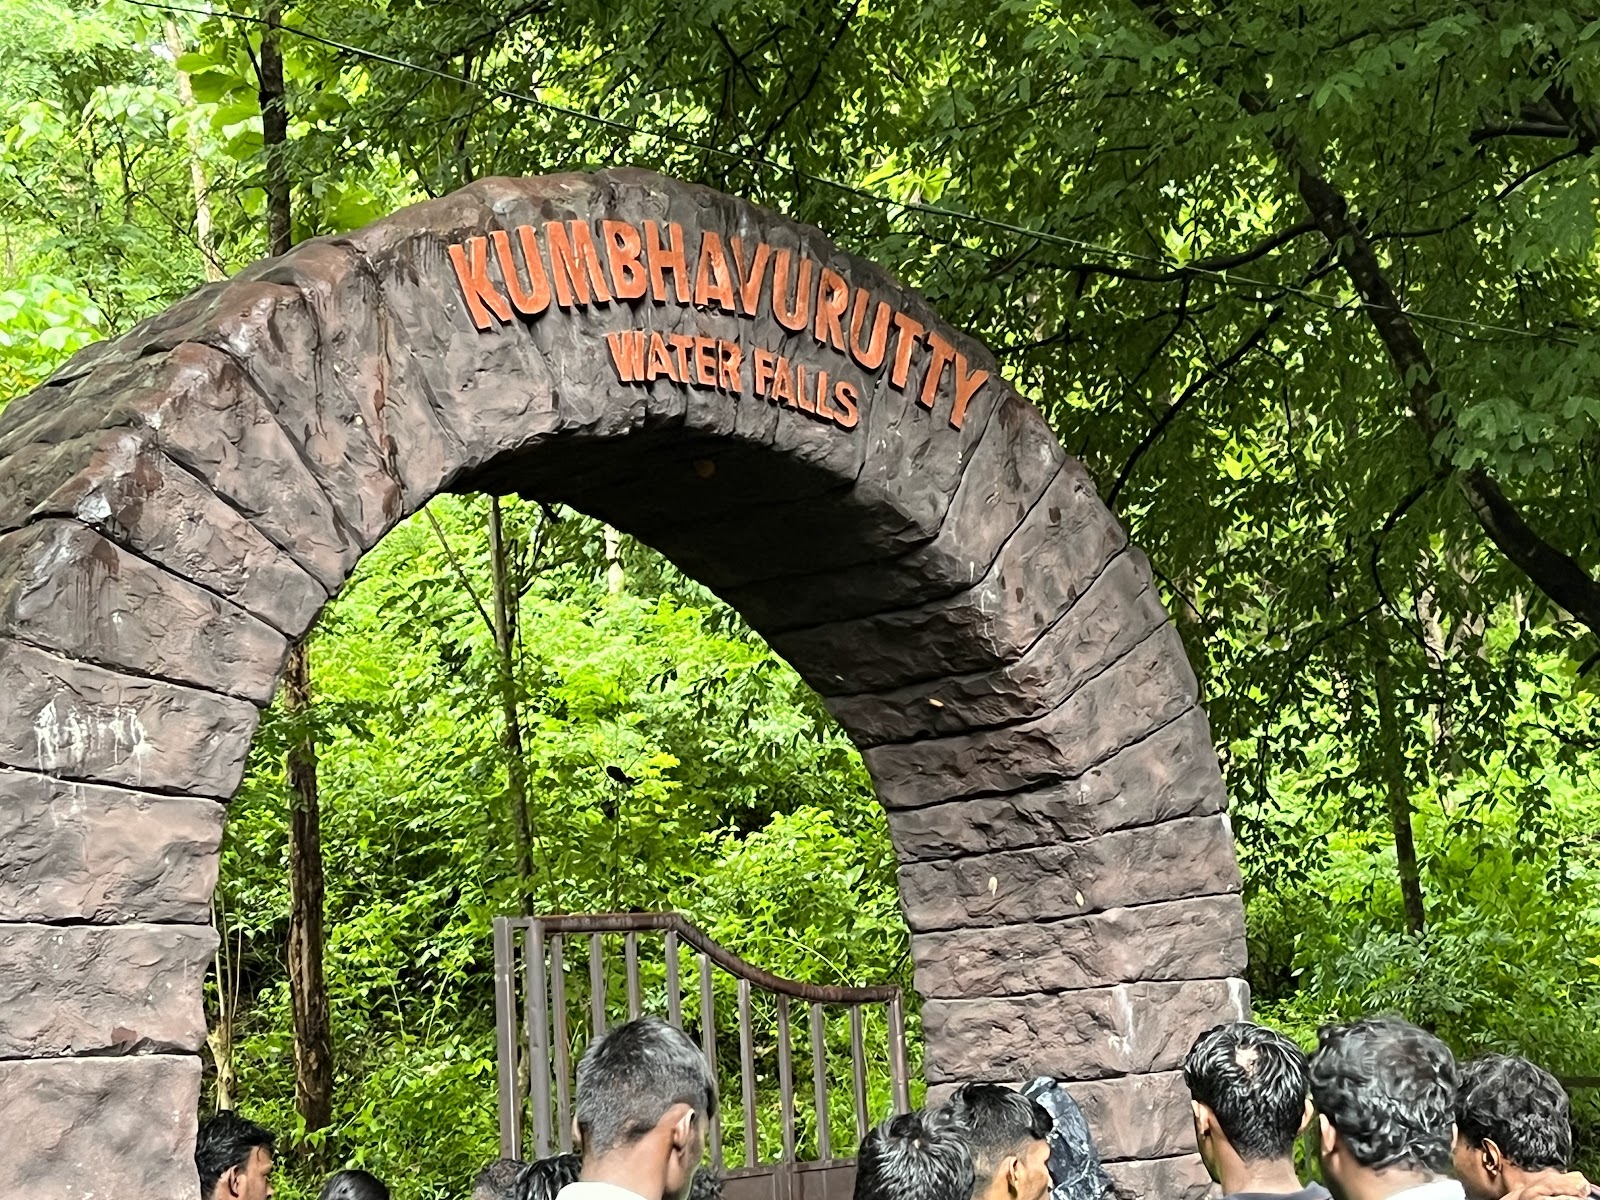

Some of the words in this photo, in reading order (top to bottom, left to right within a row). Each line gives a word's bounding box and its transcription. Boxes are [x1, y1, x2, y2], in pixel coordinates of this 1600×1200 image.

[448, 219, 989, 430] KUMBHAVURUTTY
[607, 330, 743, 393] WATER
[753, 347, 859, 428] FALLS
